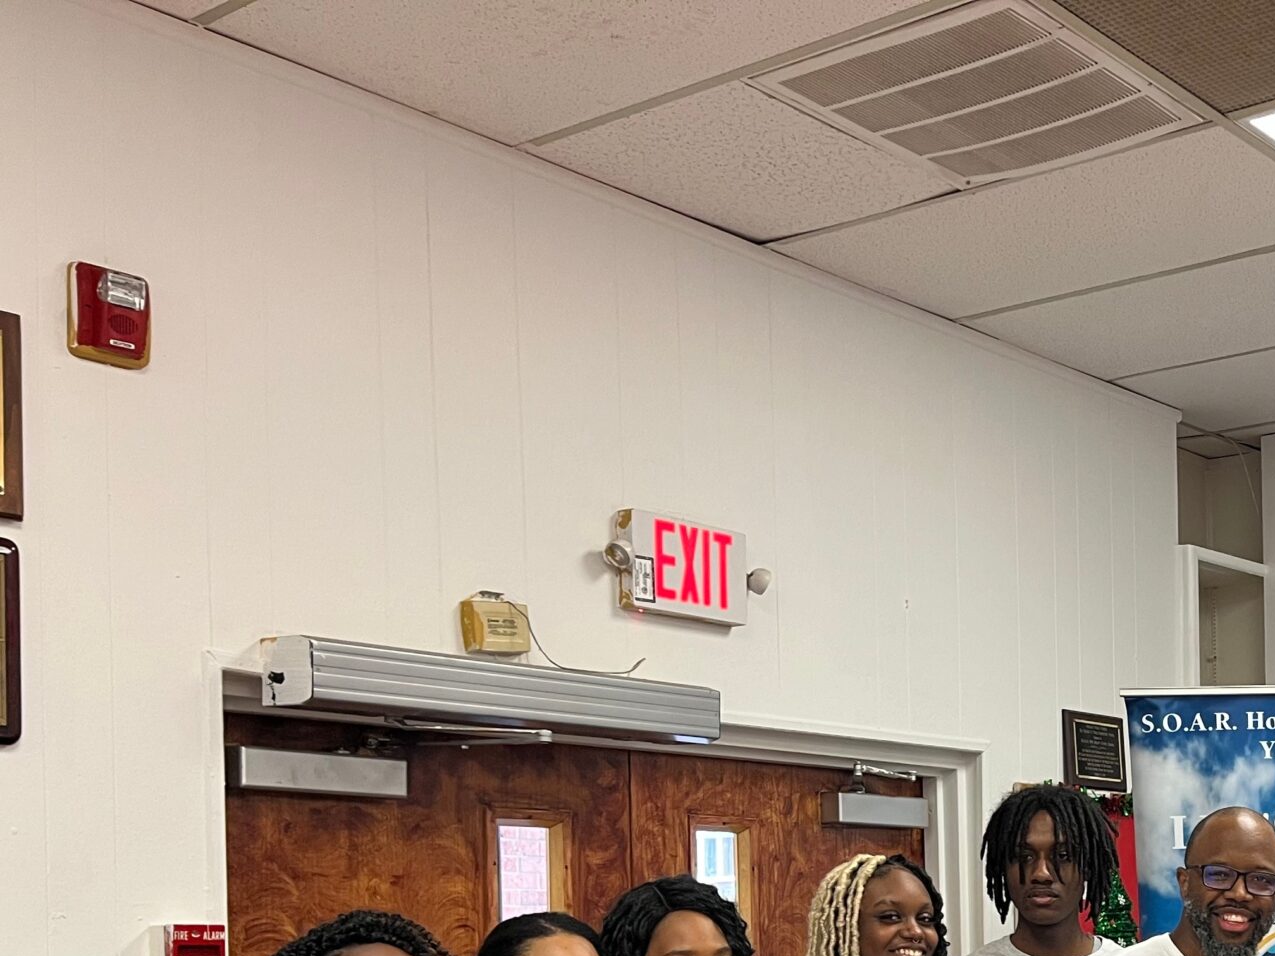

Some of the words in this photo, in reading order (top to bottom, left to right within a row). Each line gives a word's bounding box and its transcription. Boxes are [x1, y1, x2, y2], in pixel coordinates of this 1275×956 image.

[655, 518, 732, 610] EXIT
[1141, 712, 1237, 733] S.O.A.R.
[174, 930, 189, 941] FIRE
[203, 930, 225, 941] ALARM
